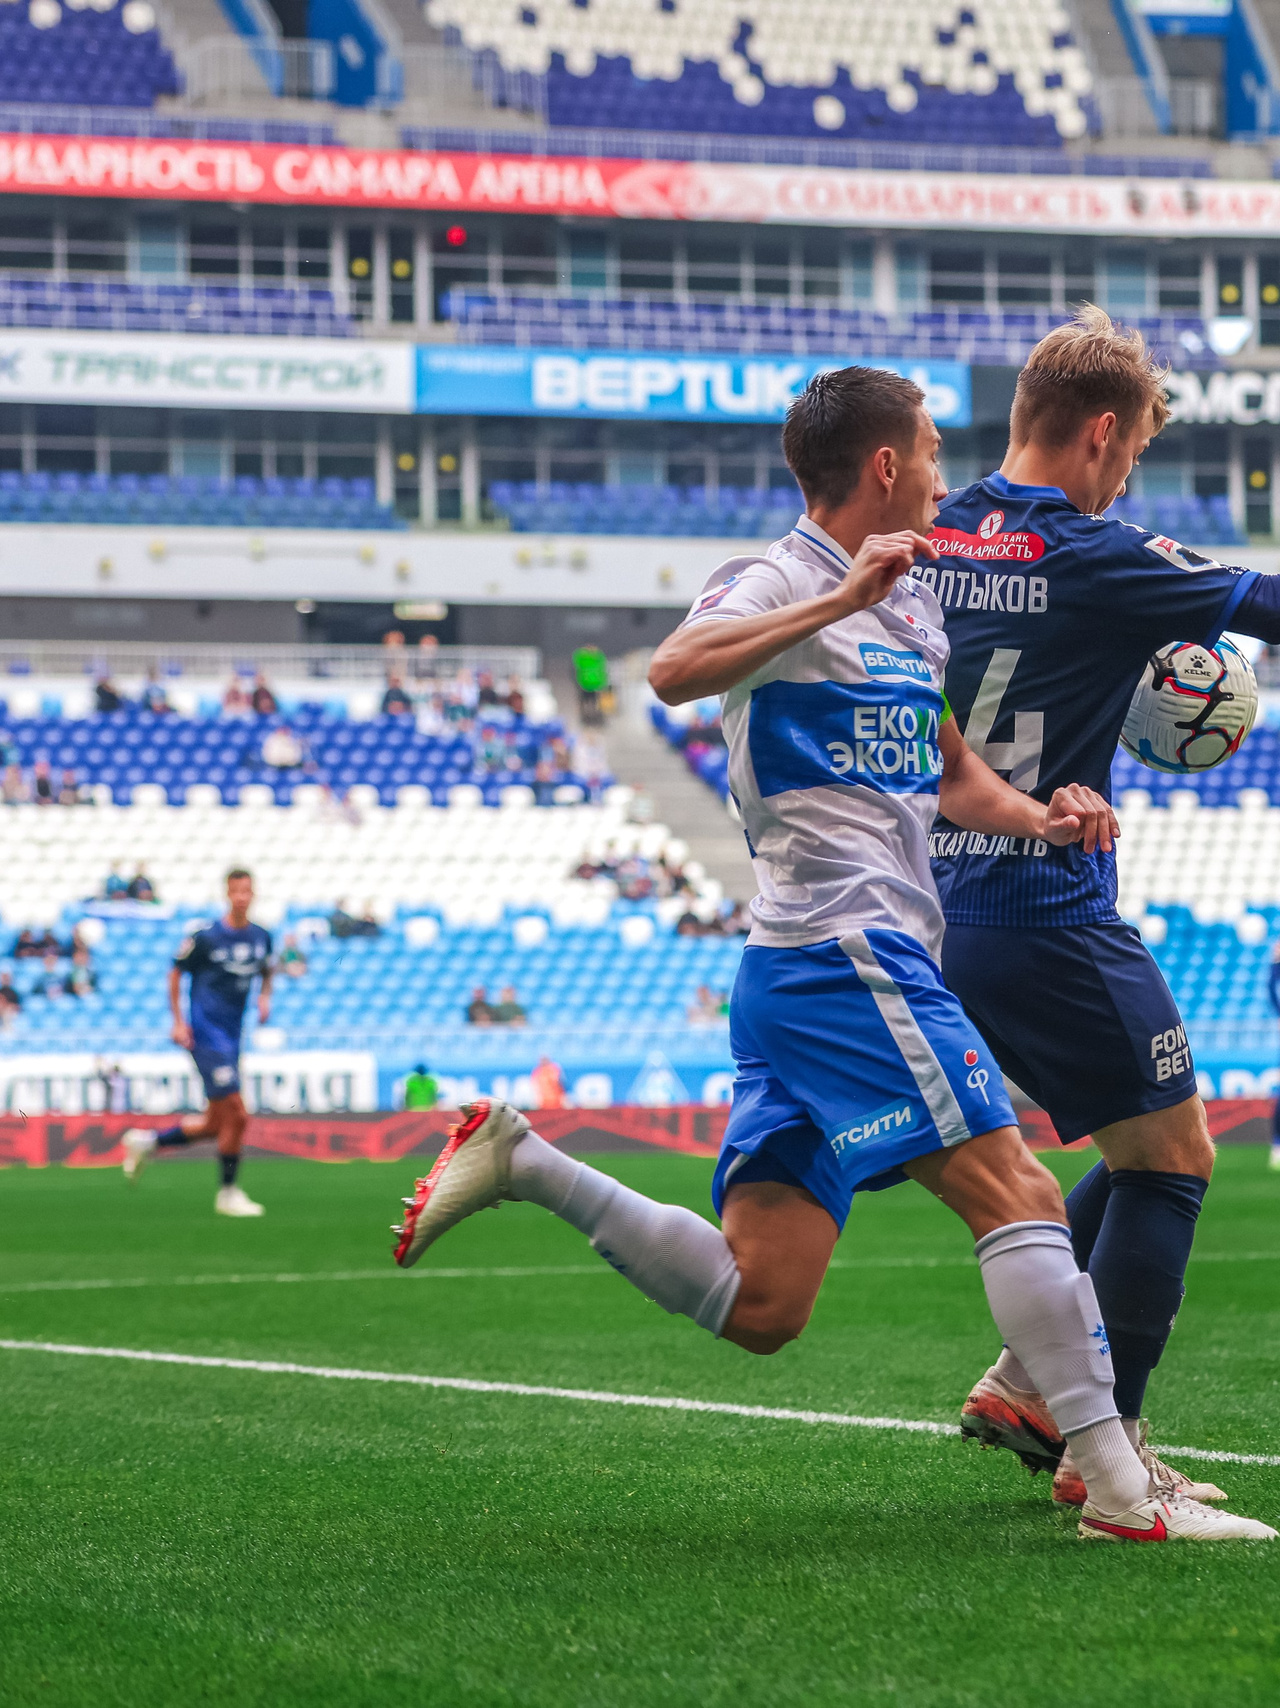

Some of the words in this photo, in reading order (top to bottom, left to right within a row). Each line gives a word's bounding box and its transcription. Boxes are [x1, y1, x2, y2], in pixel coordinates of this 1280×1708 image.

[273, 150, 463, 200] САМАРА
[469, 158, 608, 206] АРЕНА
[929, 537, 1034, 560] СОЛИДАРНОСТЬ
[1002, 533, 1030, 544] БАНК
[863, 650, 929, 675] БЕТСИТИ
[1183, 667, 1213, 678] KELME
[963, 647, 1045, 794] 4
[1150, 1022, 1187, 1059] FON
[1156, 1045, 1191, 1082] BET
